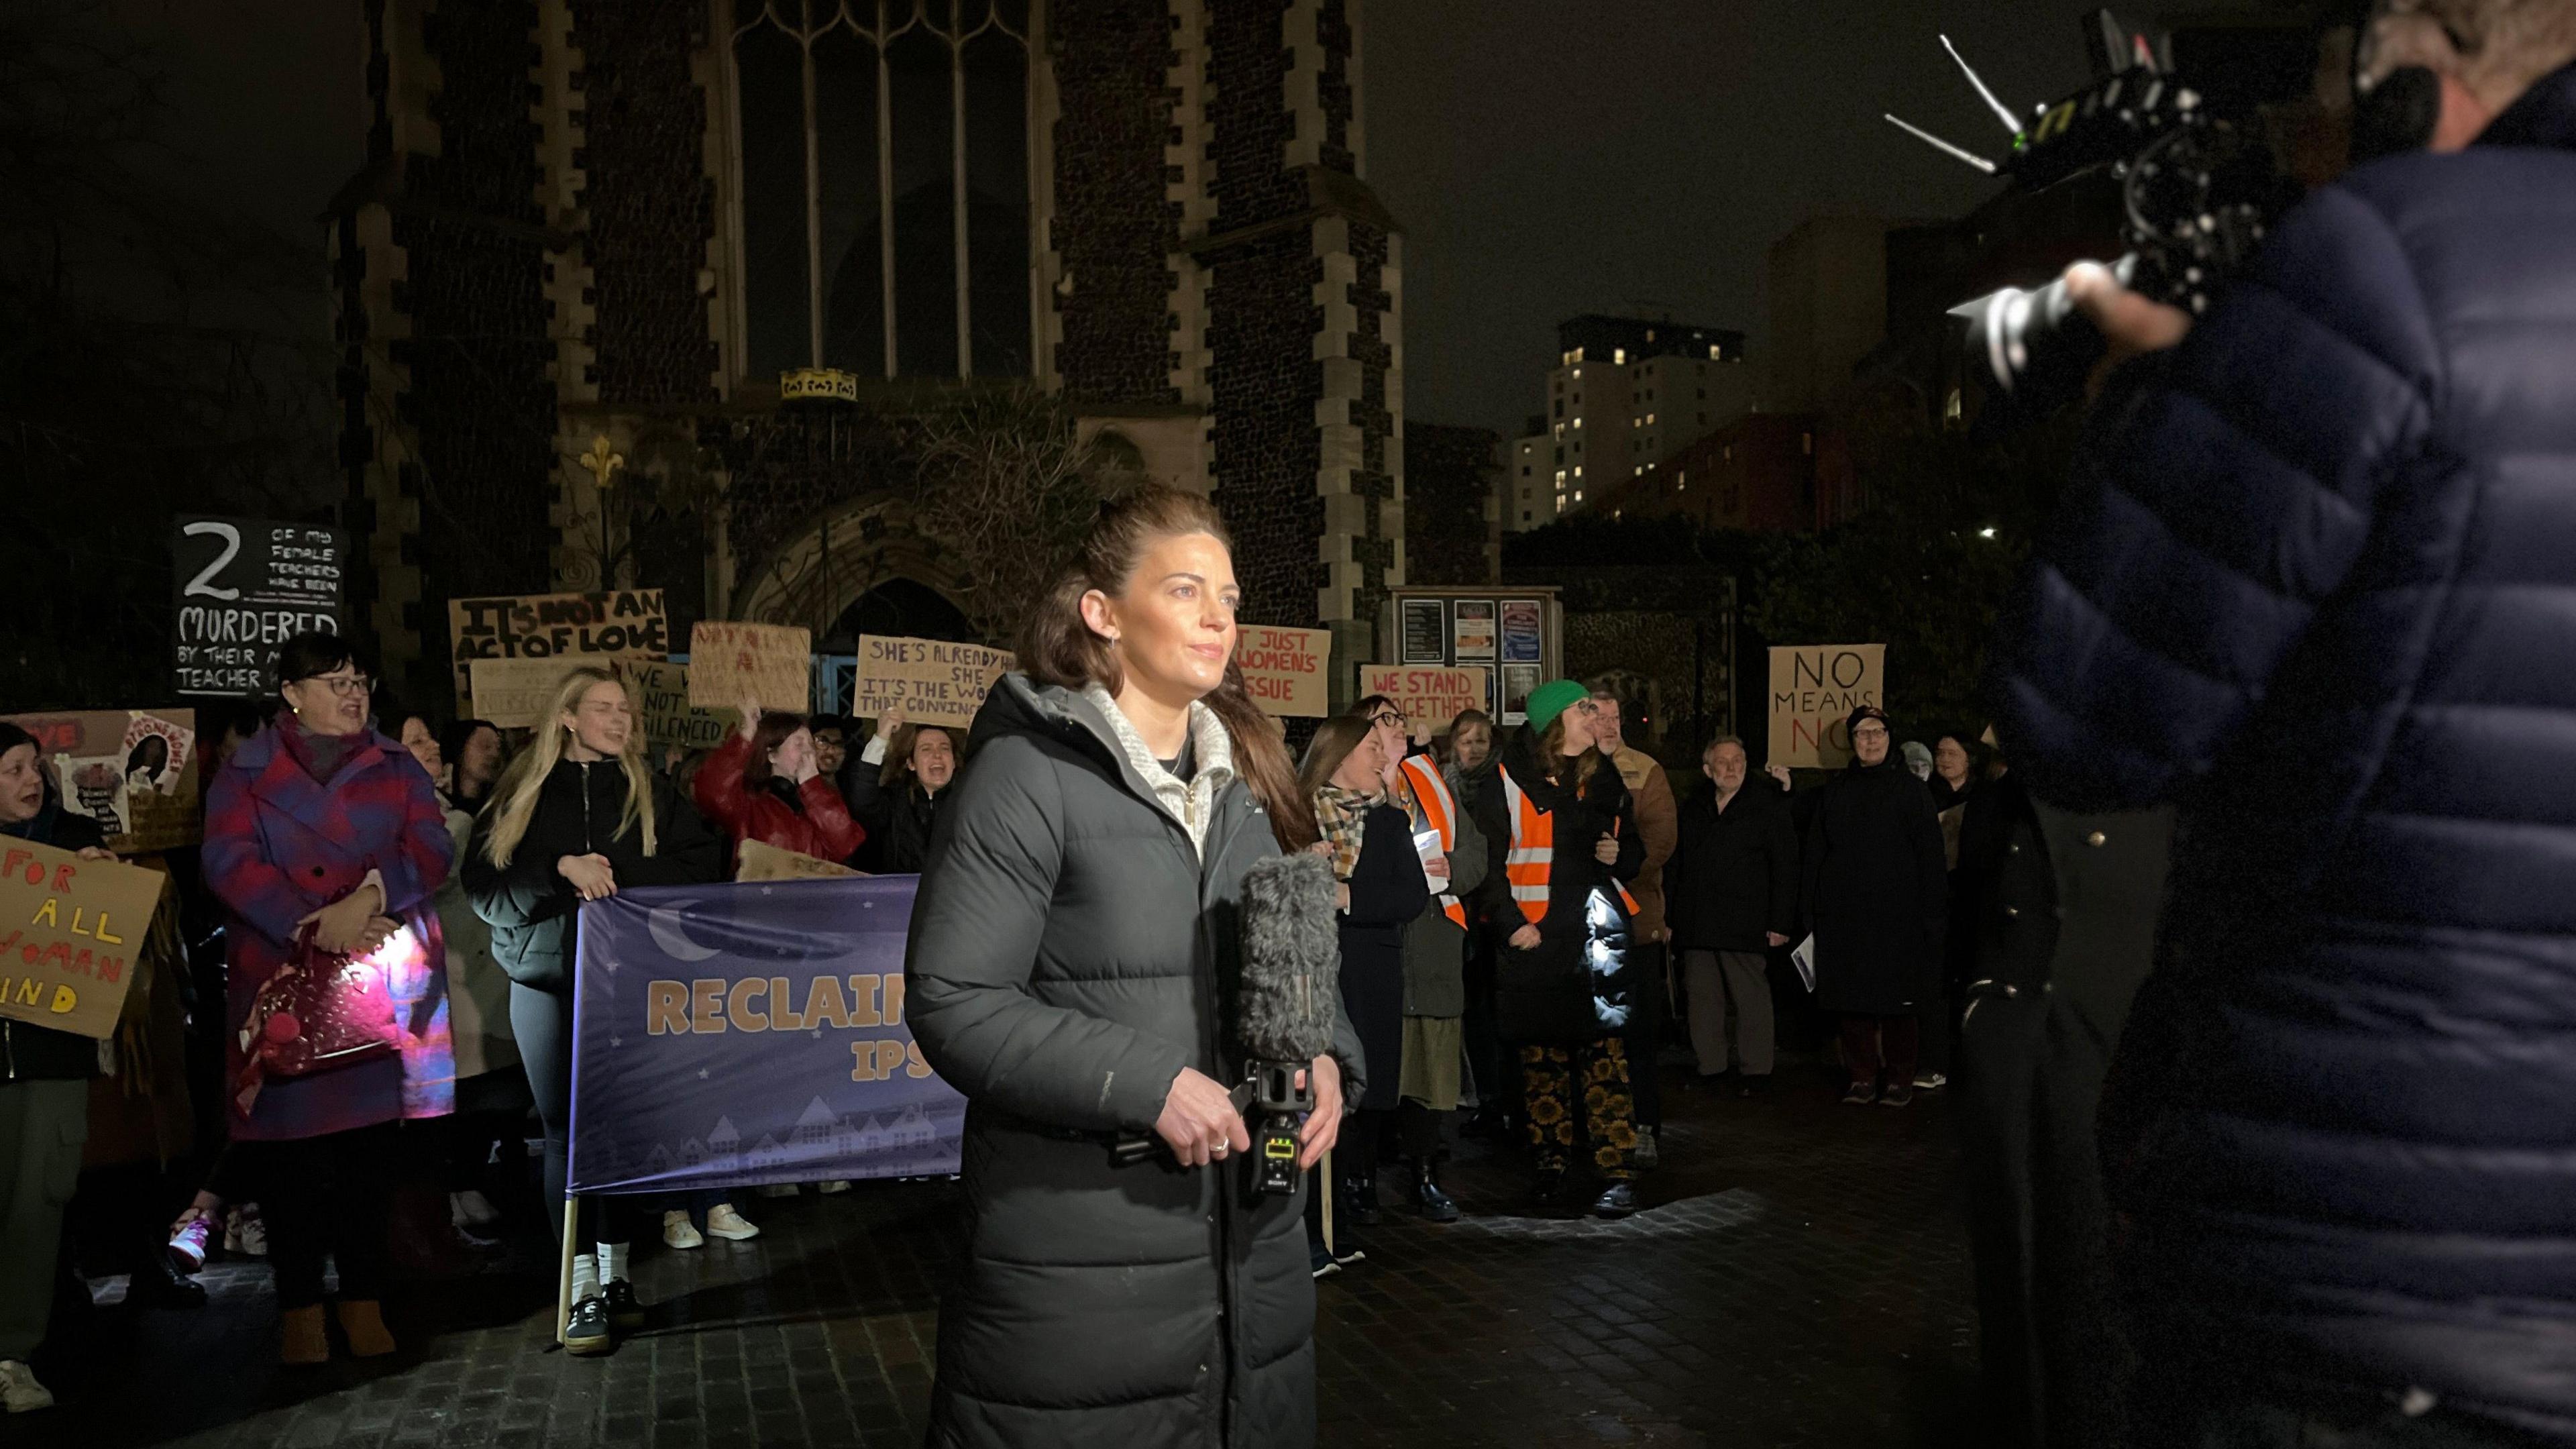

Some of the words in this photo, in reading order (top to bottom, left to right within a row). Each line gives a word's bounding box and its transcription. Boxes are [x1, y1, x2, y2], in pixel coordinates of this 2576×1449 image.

[271, 529, 295, 541] OF
[305, 530, 332, 544] MY
[184, 521, 240, 600] 2
[271, 545, 335, 561] FEMALE
[269, 562, 340, 578] TEACHERS
[540, 592, 609, 625] NOT
[613, 591, 663, 619] AN
[179, 606, 337, 644] MURDERED
[456, 629, 521, 659] ACT
[522, 627, 573, 658] OF
[580, 617, 668, 653] LOVE
[1259, 630, 1309, 651] JUST
[177, 645, 199, 663] BY
[204, 646, 255, 665] THEIR
[869, 641, 926, 663] SHE'S
[934, 645, 998, 667] ALREADY
[1237, 649, 1318, 674] WOMEN'S
[176, 667, 260, 687] TEACHER
[951, 666, 983, 685] SHE
[1794, 651, 1864, 689] NO
[863, 678, 907, 696] IT'S
[912, 680, 950, 699] THE
[956, 684, 991, 701] WO
[1245, 676, 1294, 701] SSUE
[1373, 673, 1399, 692] WE
[1407, 671, 1472, 694] STAND
[643, 692, 682, 713] NOT
[906, 697, 981, 716] CONVINC
[1391, 696, 1476, 719] OGETHER
[1775, 691, 1874, 713] MEANS
[3, 849, 76, 894] FOR
[32, 898, 123, 945] ALL
[0, 977, 78, 1013] IND
[851, 1039, 934, 1081] IPS
